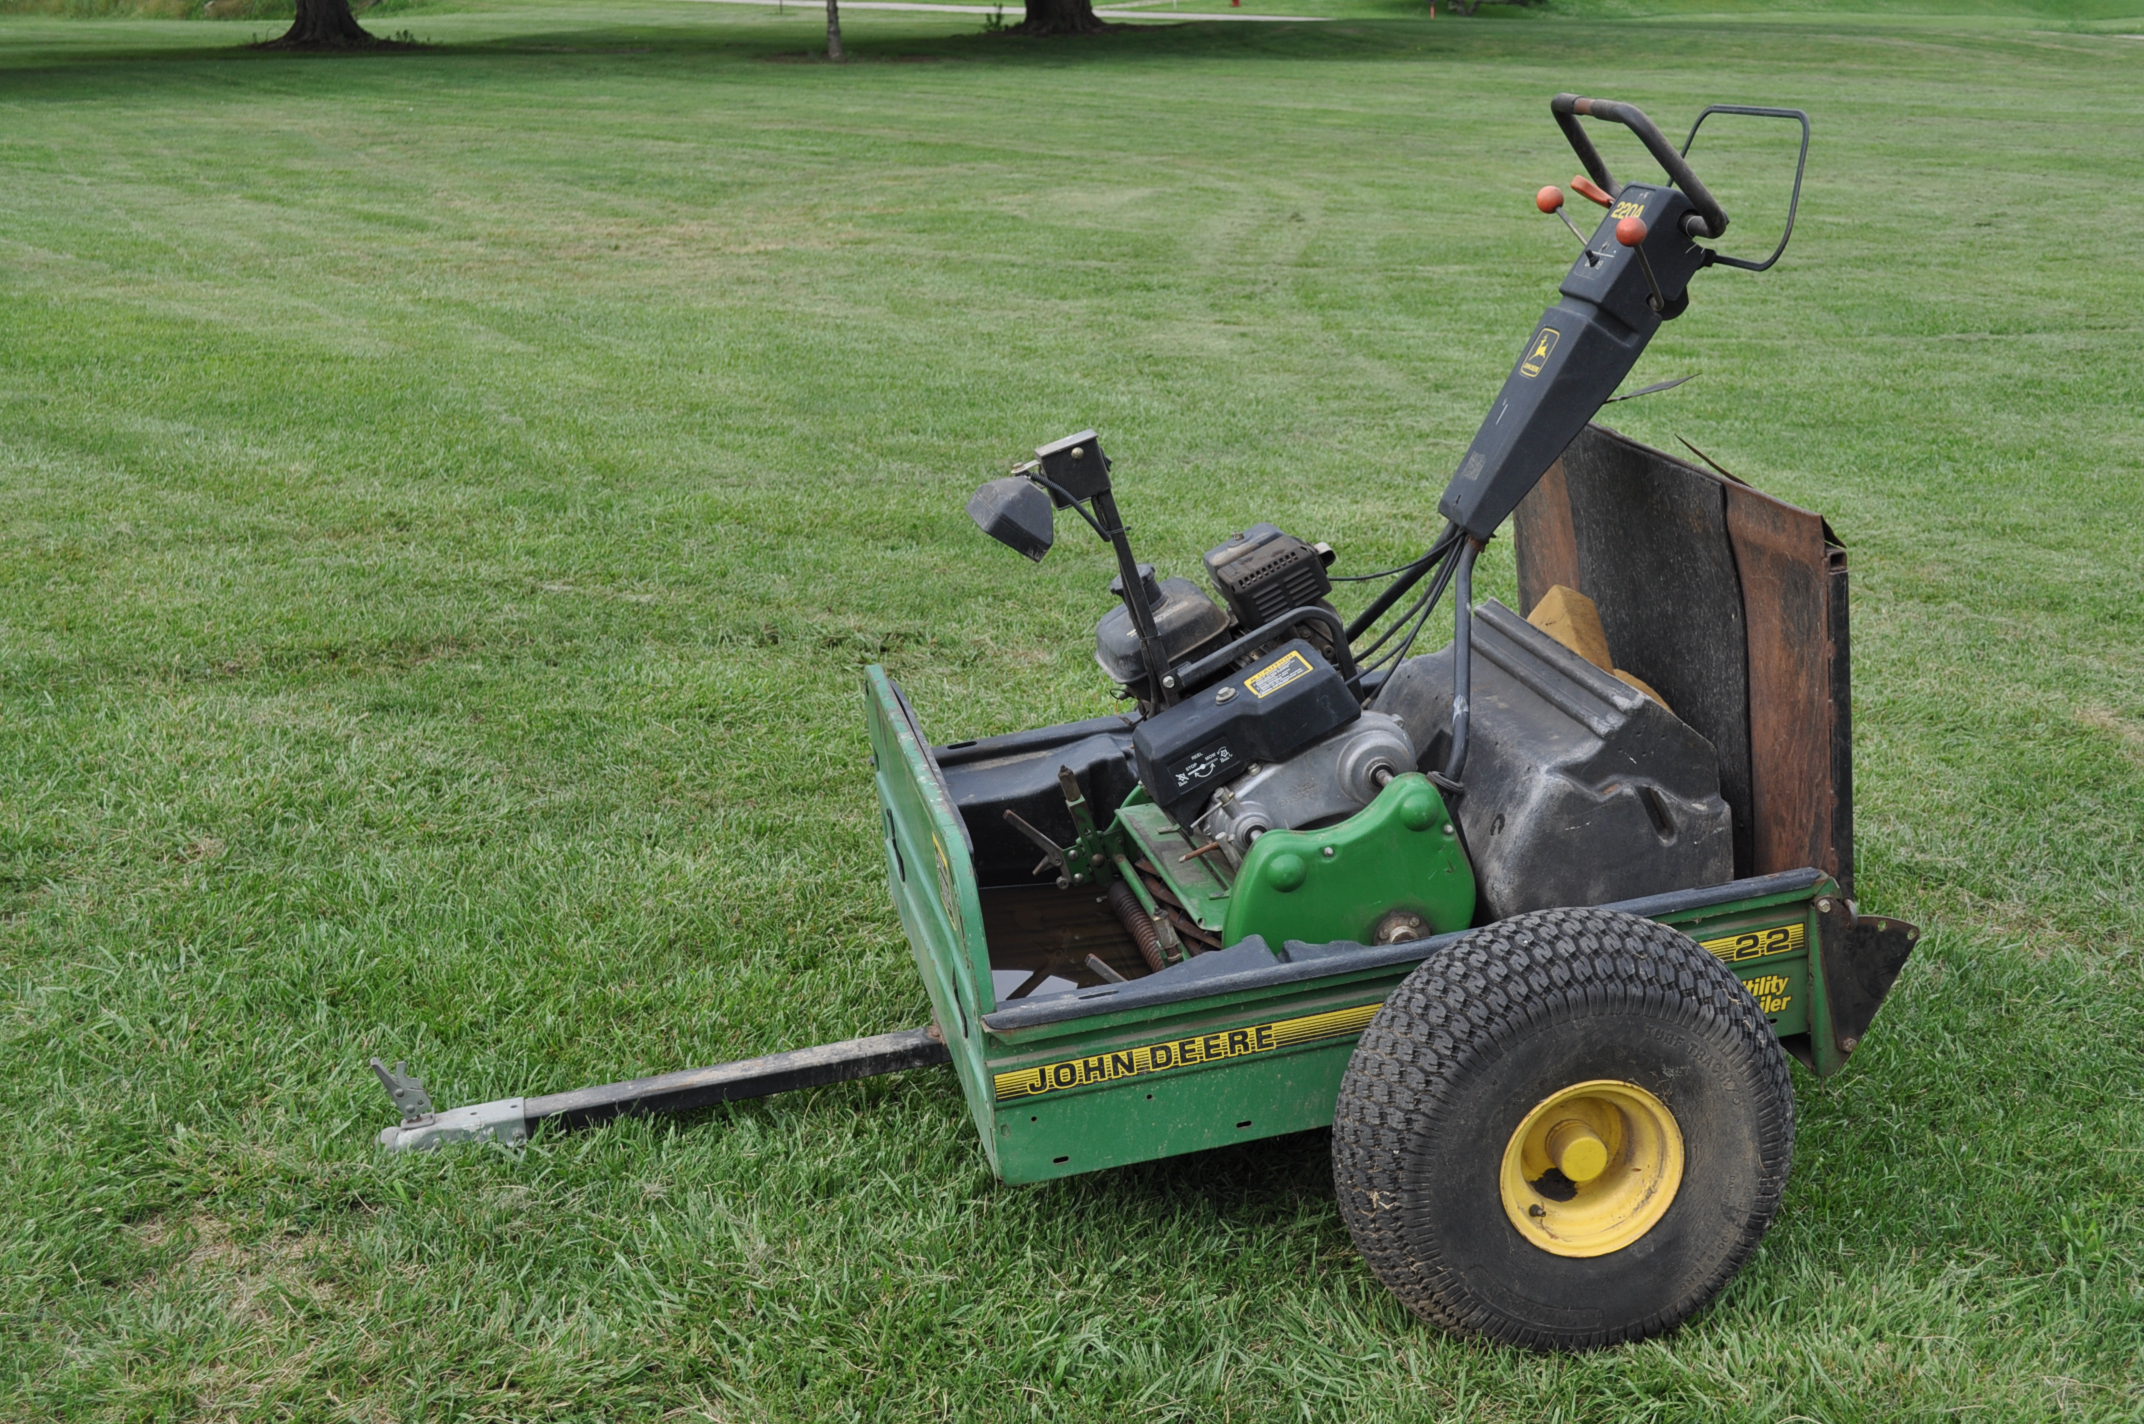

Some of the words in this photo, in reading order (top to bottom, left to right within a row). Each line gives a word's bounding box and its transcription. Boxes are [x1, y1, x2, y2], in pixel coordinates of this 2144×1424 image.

[1185, 762, 1198, 771] STOP
[1742, 975, 1789, 996] tility
[1760, 995, 1792, 1013] iler
[1028, 1054, 1137, 1095] JOHN
[1149, 1024, 1277, 1072] DEERE
